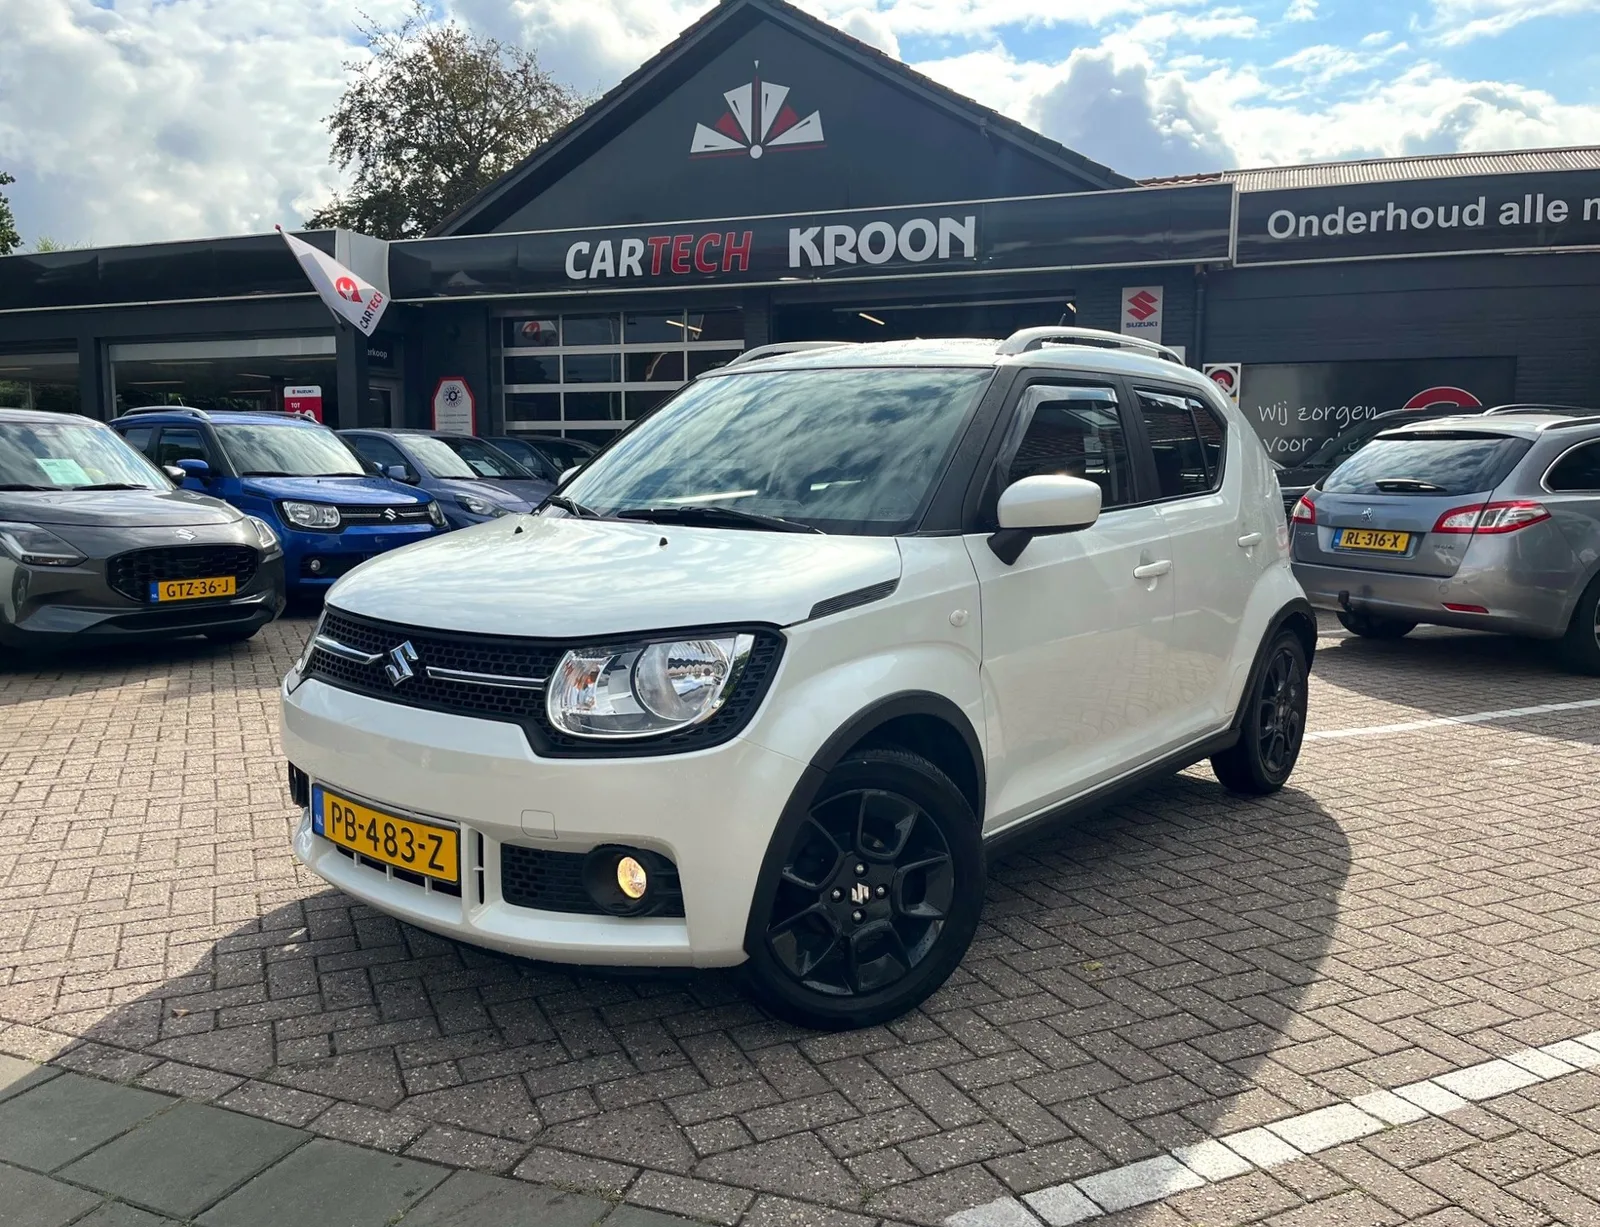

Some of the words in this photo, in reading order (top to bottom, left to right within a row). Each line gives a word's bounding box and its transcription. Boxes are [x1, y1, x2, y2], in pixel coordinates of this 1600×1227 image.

[1267, 196, 1486, 239] Onderhoud
[1499, 193, 1568, 225] alle
[564, 230, 753, 280] CARTECH
[788, 215, 976, 268] KROON
[1258, 400, 1288, 426] Wij
[1297, 405, 1377, 429] zorgen
[1263, 436, 1313, 453] voor
[1345, 531, 1400, 549] RL-316-X
[166, 579, 229, 598] GTZ-36-J
[315, 814, 323, 827] NL
[331, 801, 445, 872] PB-483-Z
